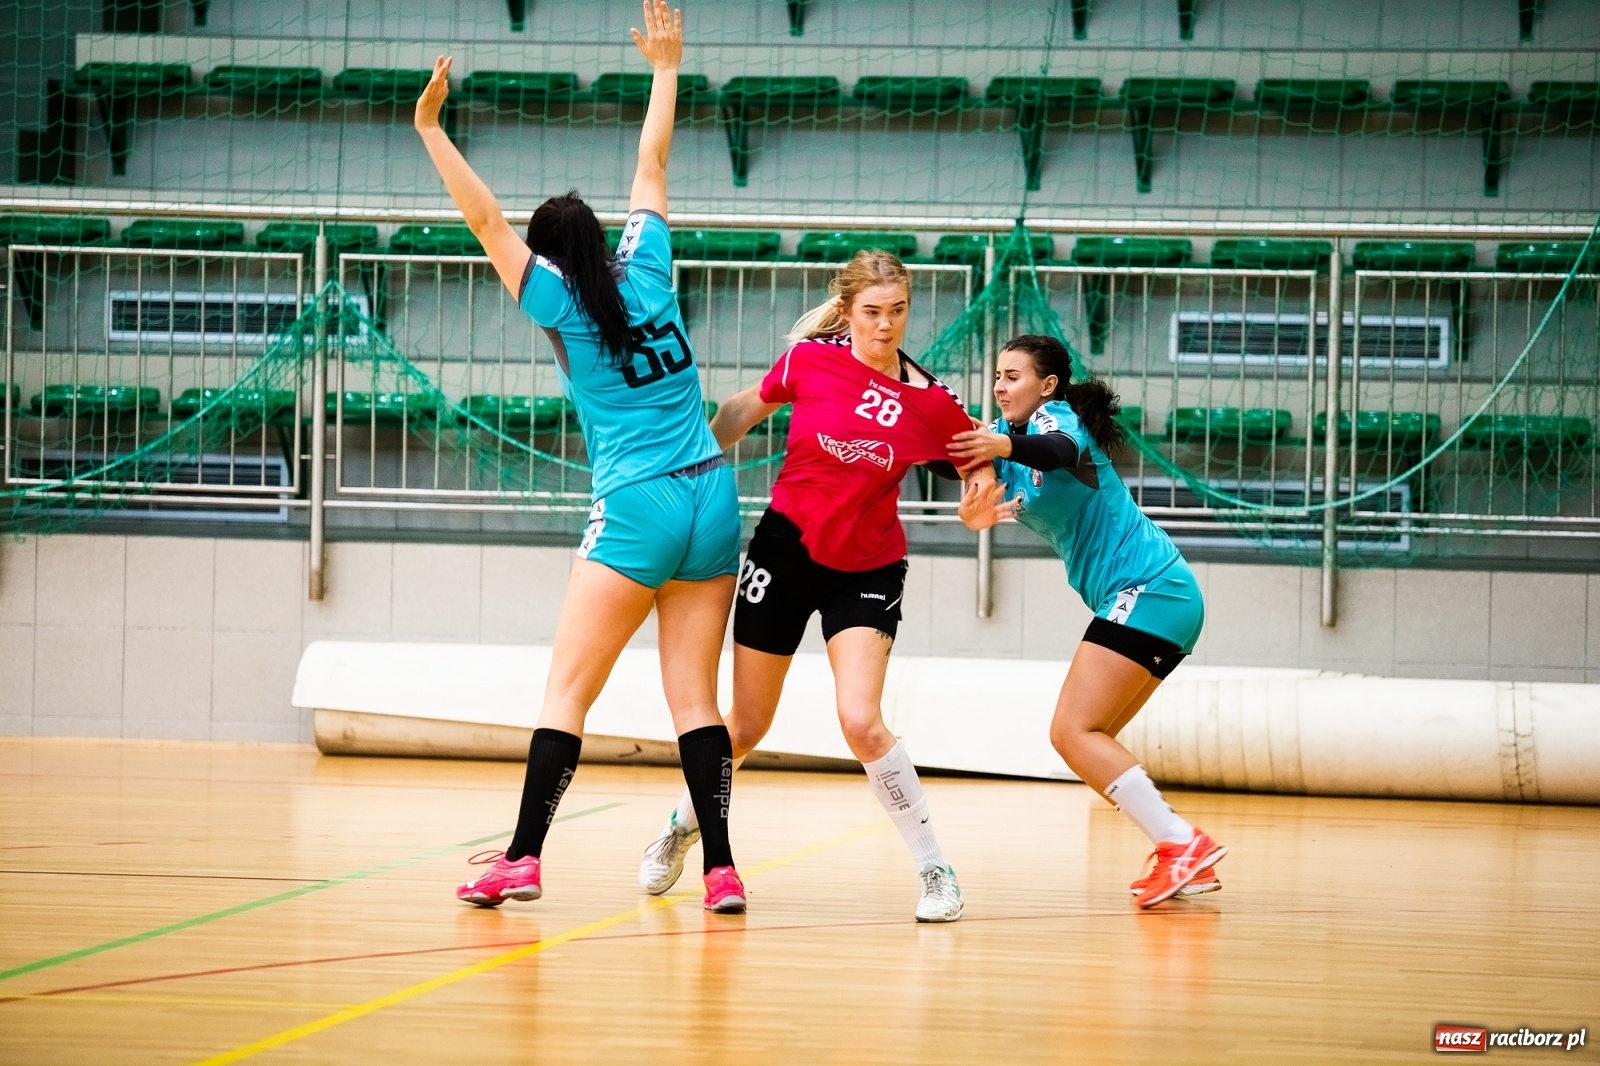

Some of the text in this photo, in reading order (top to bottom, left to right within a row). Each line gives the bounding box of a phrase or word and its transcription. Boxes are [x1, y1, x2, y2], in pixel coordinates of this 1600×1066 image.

[869, 379, 901, 399] hummel
[855, 389, 903, 427] 28
[739, 559, 772, 604] 28
[860, 592, 886, 601] hummel
